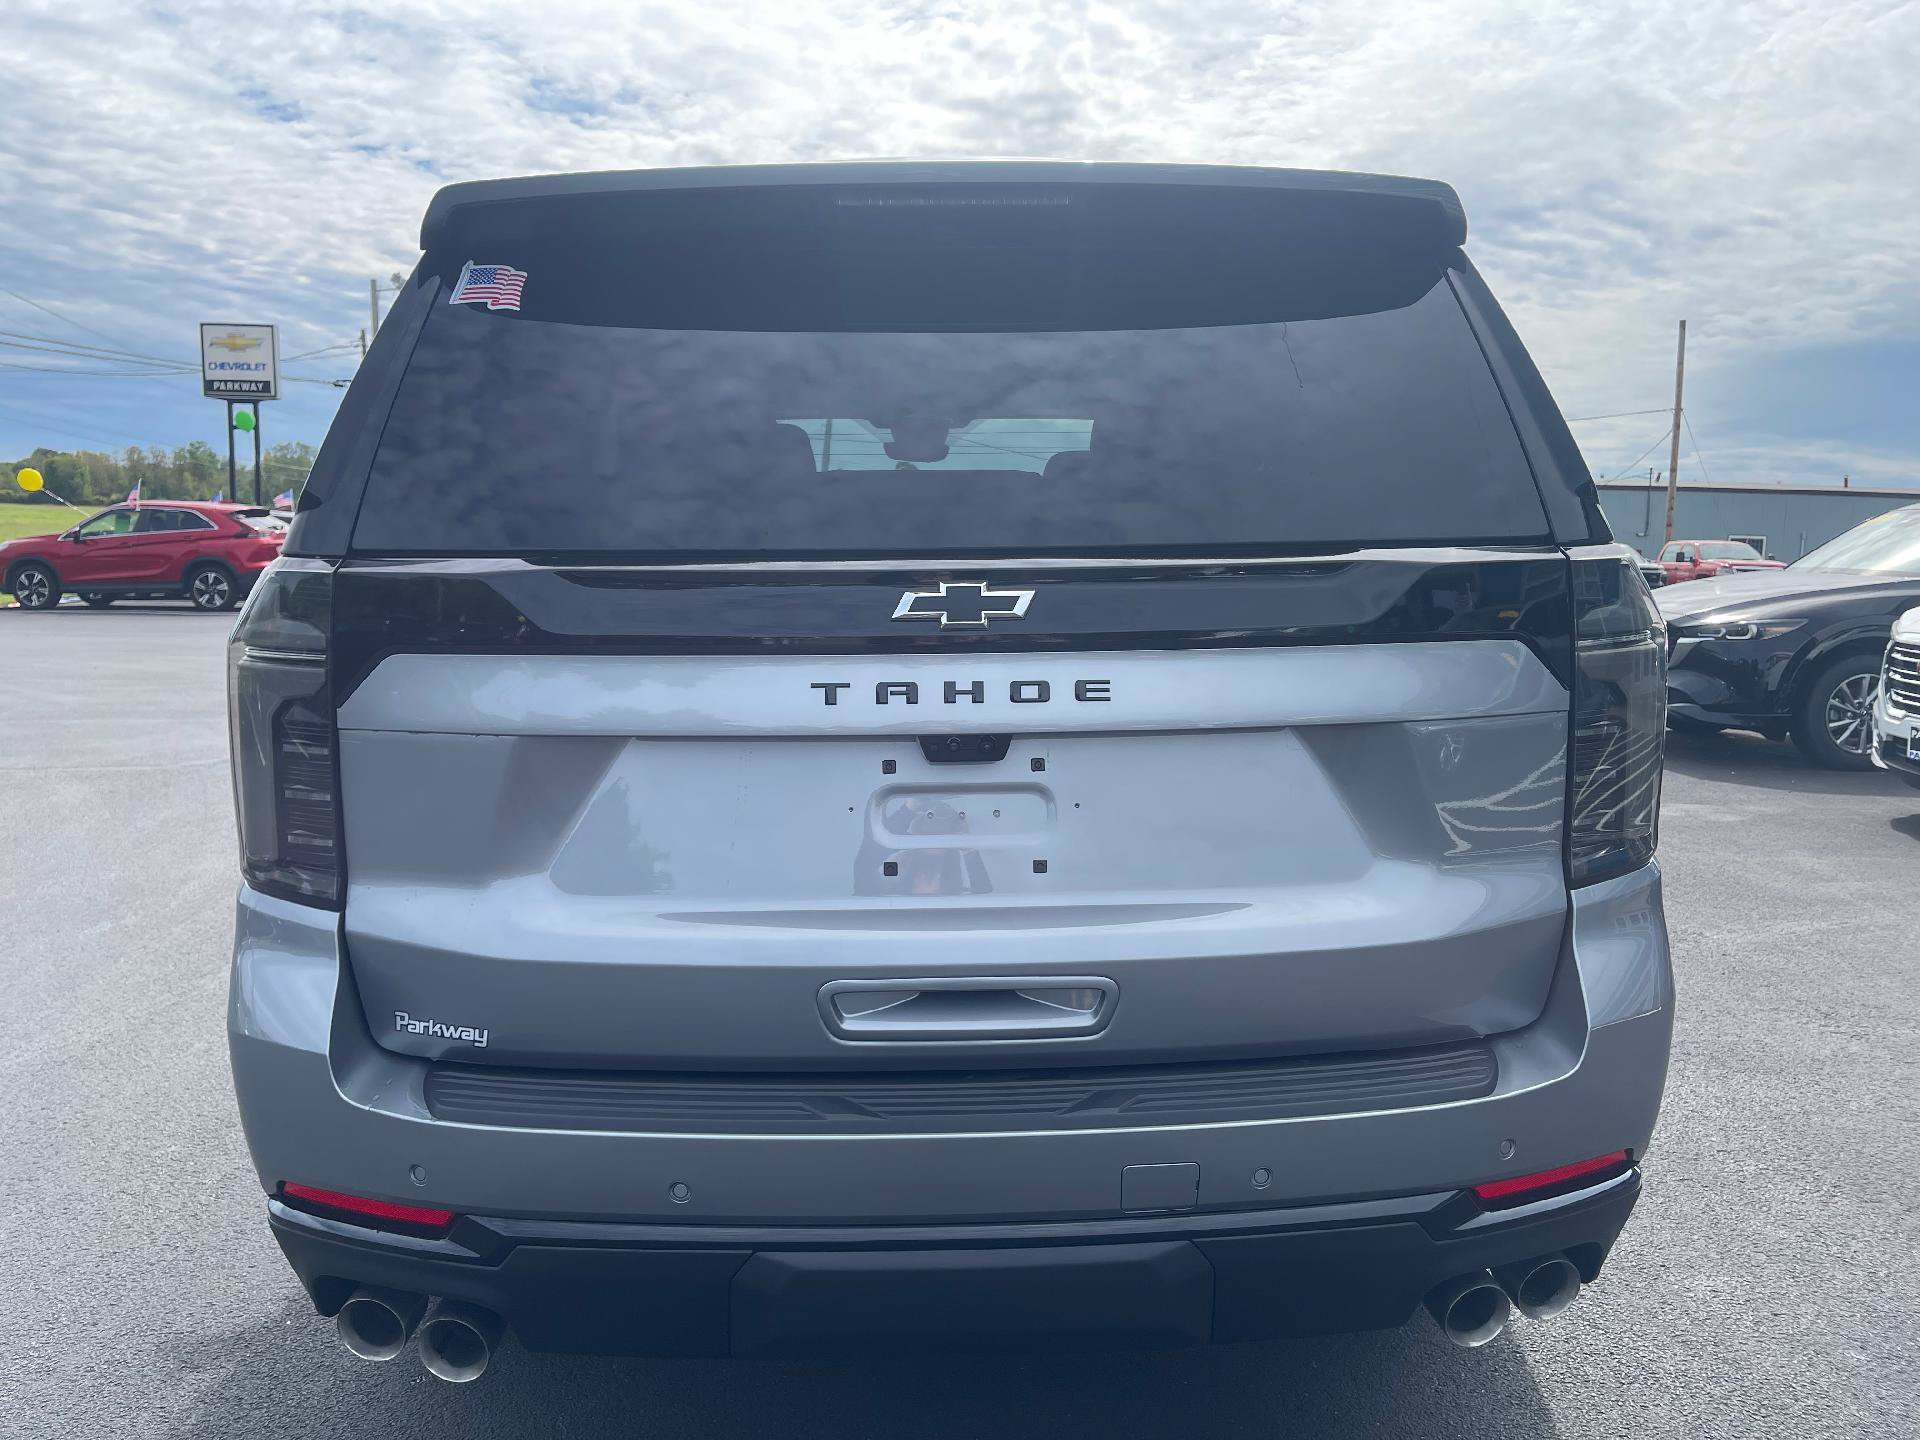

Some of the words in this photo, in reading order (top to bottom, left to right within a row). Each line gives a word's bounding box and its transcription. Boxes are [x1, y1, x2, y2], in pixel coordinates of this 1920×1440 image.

[208, 362, 267, 371] CHEVROLET
[213, 381, 264, 391] PARKWAY
[810, 679, 1111, 705] TAHOE
[394, 1011, 488, 1047] Parkway
